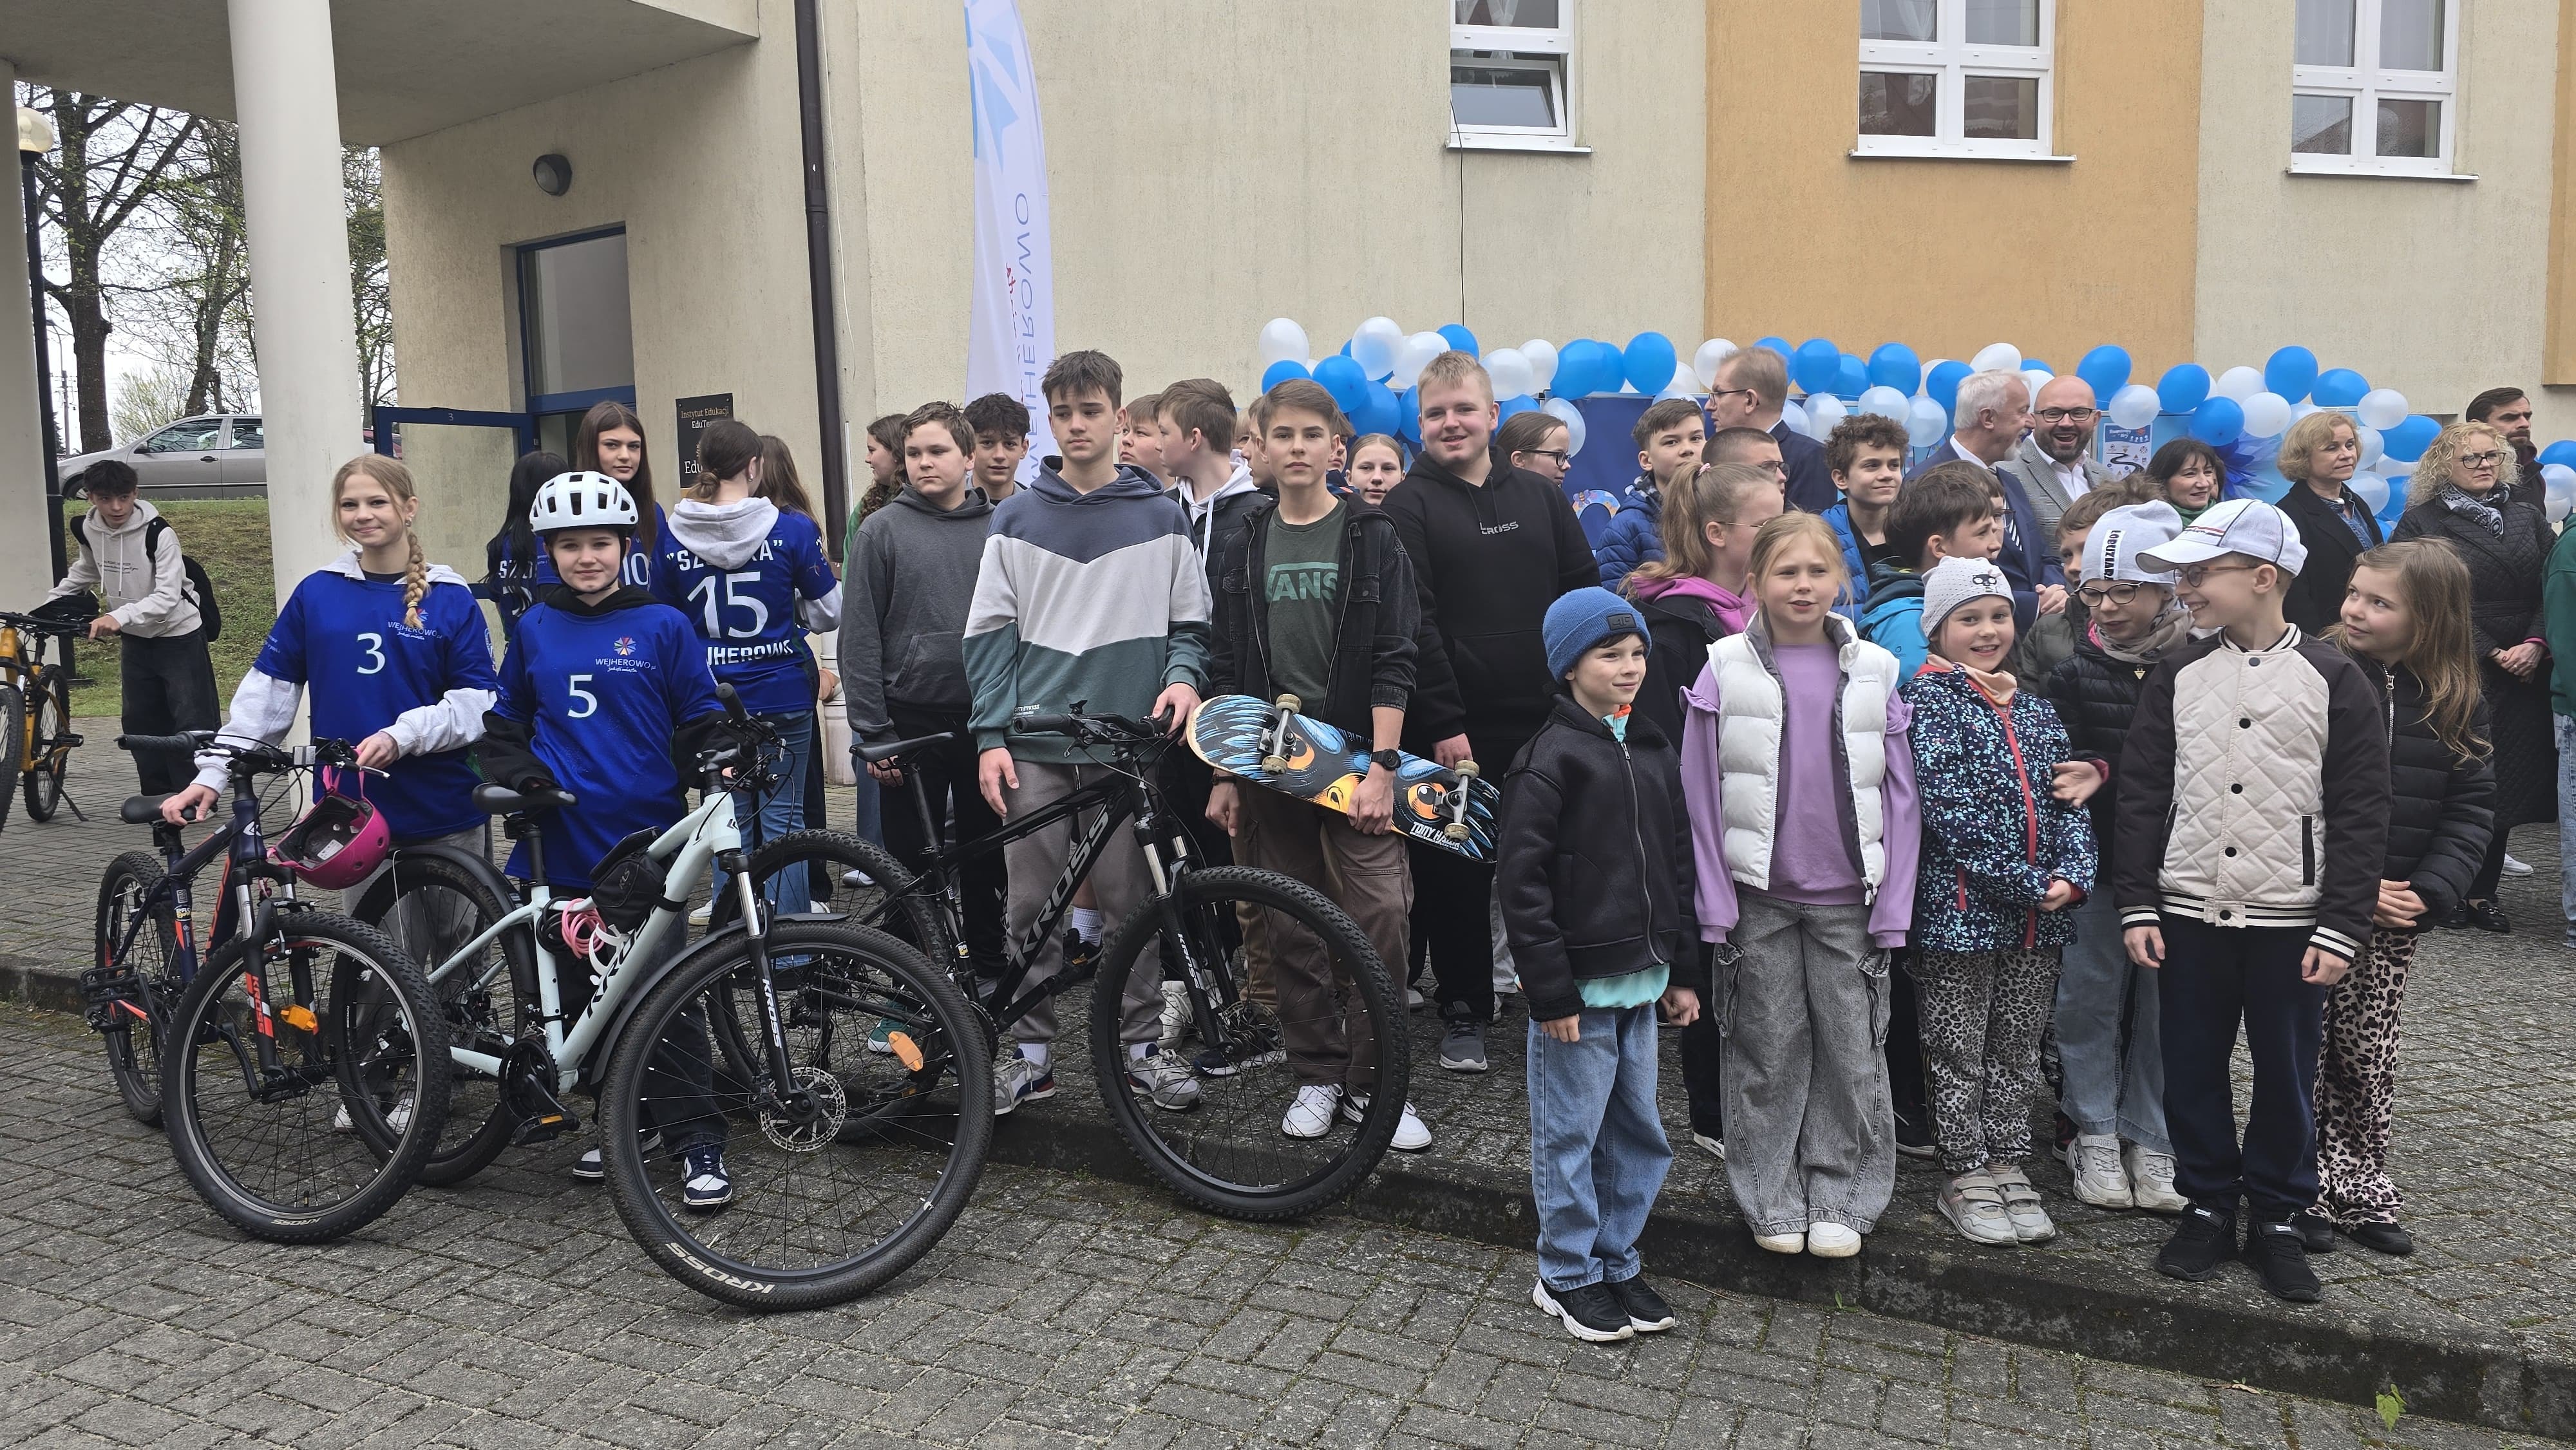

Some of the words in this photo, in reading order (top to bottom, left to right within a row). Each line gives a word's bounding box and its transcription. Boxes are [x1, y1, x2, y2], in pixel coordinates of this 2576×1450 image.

[448, 413, 454, 421] 3
[681, 409, 703, 419] Instytut
[692, 420, 710, 429] EduTe
[623, 552, 650, 586] 10
[687, 571, 768, 639] 15
[357, 633, 386, 674] 3
[568, 674, 598, 718] 5
[1016, 804, 1108, 968] KROSS
[1177, 933, 1201, 989] KROSS
[252, 975, 265, 1034] KROSS
[762, 978, 782, 1049] KROSS
[2090, 1138, 2117, 1149] DODGERS
[270, 1217, 322, 1226] KROSS
[665, 1242, 775, 1294] KROSS
